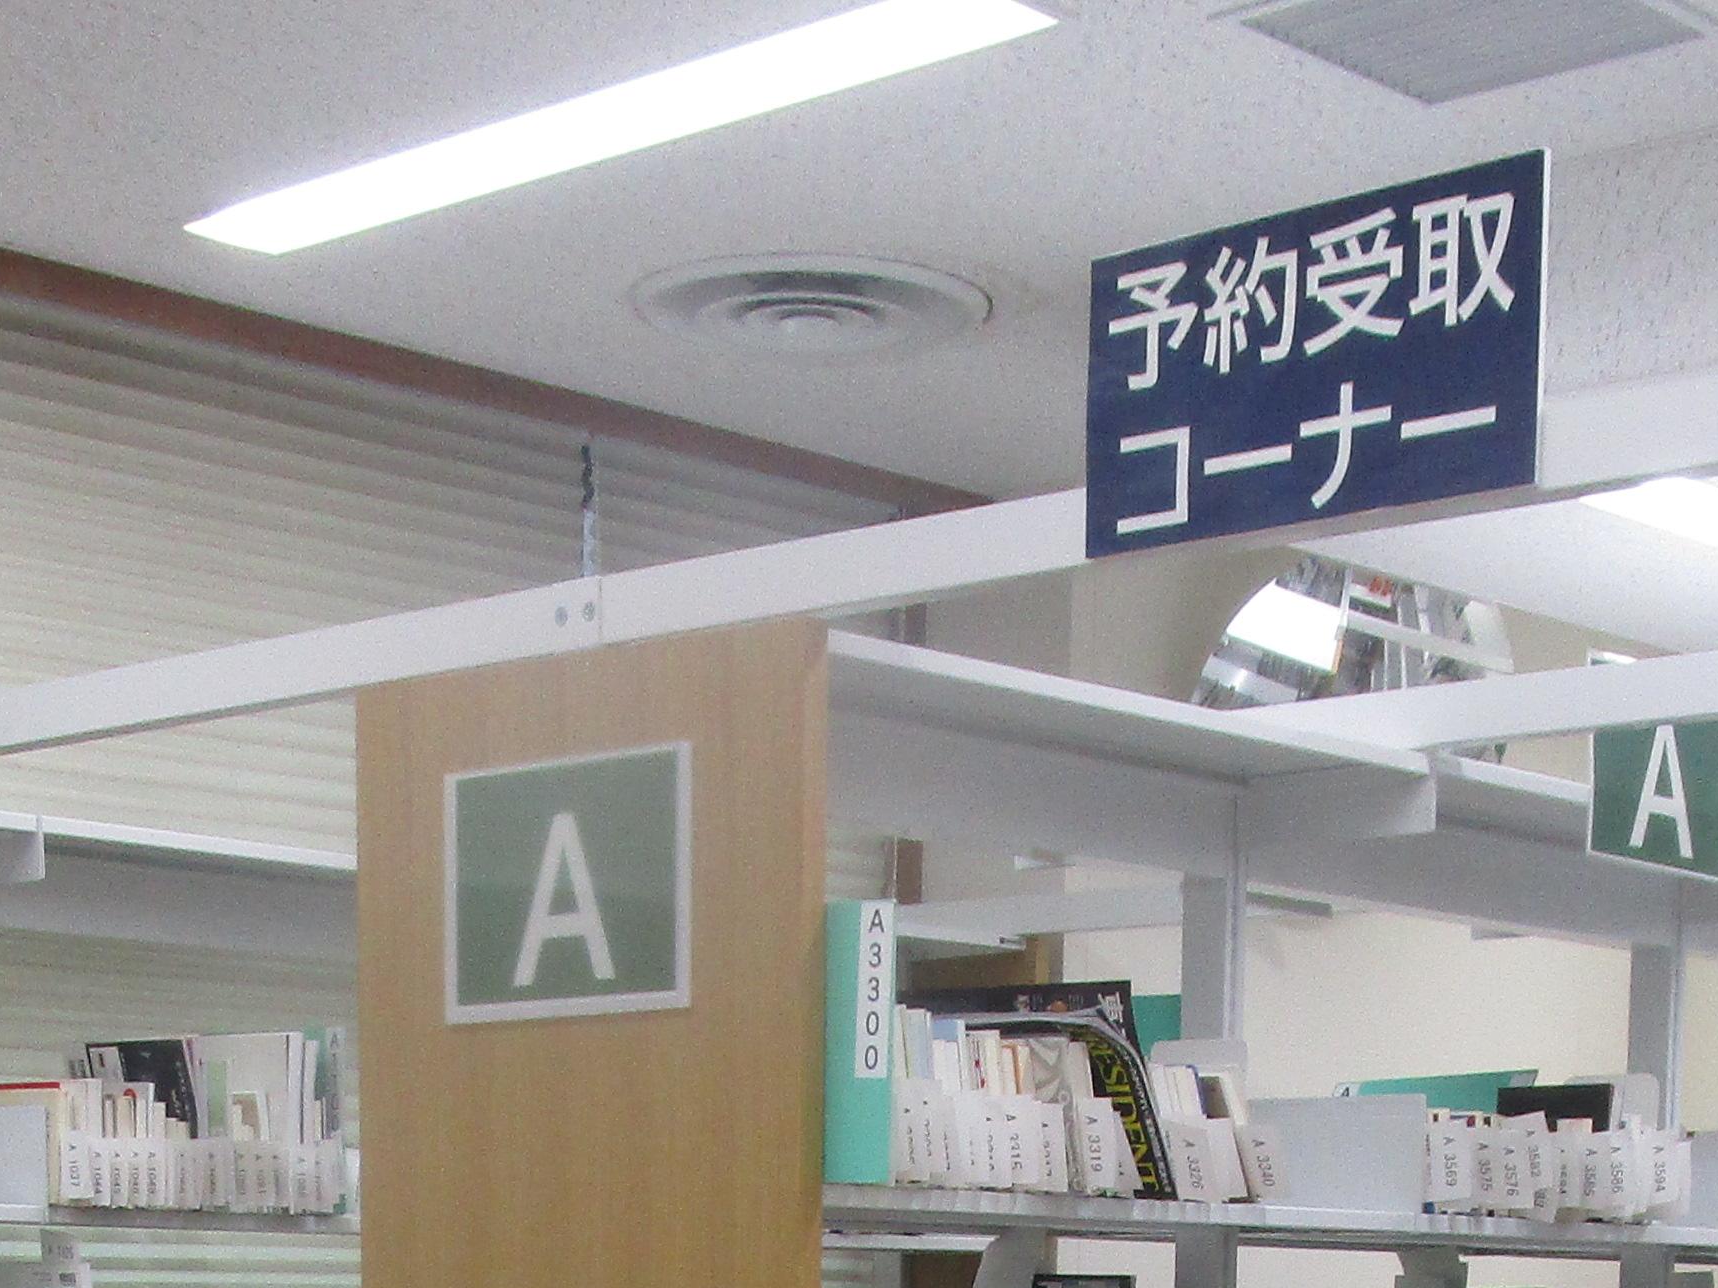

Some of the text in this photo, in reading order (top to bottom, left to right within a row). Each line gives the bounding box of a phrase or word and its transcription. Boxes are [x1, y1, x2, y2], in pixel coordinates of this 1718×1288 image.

[1108, 191, 1515, 390] 予約受取
[1116, 381, 1497, 535] コーナー
[1629, 725, 1694, 859] A
[513, 812, 616, 987] A
[863, 907, 884, 1071] A3300
[1087, 1134, 1103, 1173] 3319
[1443, 1154, 1458, 1187] 3569
[69, 1160, 81, 1189] 1037
[1480, 1159, 1493, 1192] 3575
[1504, 1162, 1519, 1197] 3576
[1610, 1162, 1624, 1194] 3586
[1654, 1162, 1666, 1193] 3594
